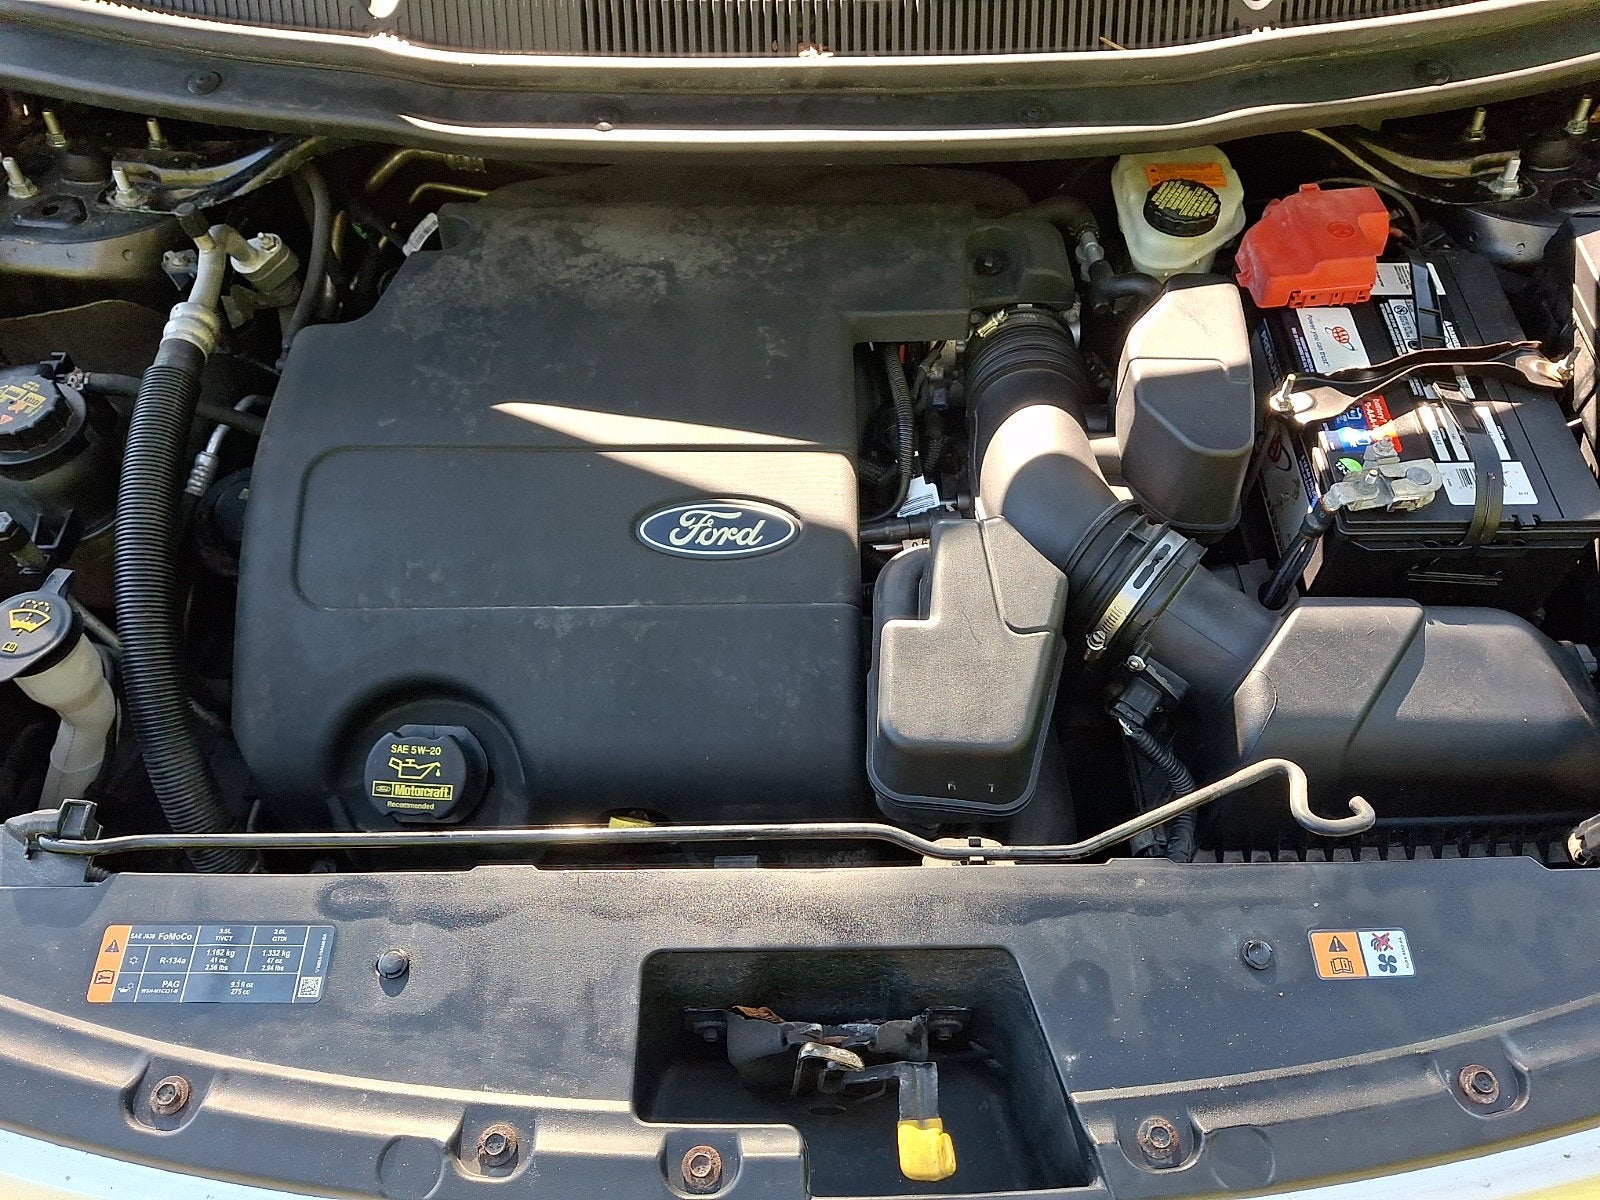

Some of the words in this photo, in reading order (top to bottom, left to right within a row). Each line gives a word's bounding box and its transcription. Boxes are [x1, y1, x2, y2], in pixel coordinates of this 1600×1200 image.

[1307, 314, 1315, 330] Power
[1260, 330, 1279, 379] PREMIUM
[669, 509, 766, 546] Ford
[390, 744, 409, 754] SAE
[411, 745, 442, 756] 5W-20
[394, 785, 450, 798] Motorcraft
[386, 801, 435, 810] Recommended
[158, 932, 193, 941] FoMoCo
[206, 948, 225, 956] 1.162
[225, 949, 236, 958] kg
[262, 949, 280, 957] 1.332
[281, 949, 291, 958] kg
[159, 956, 187, 965] R-134a
[161, 980, 180, 988] PAG
